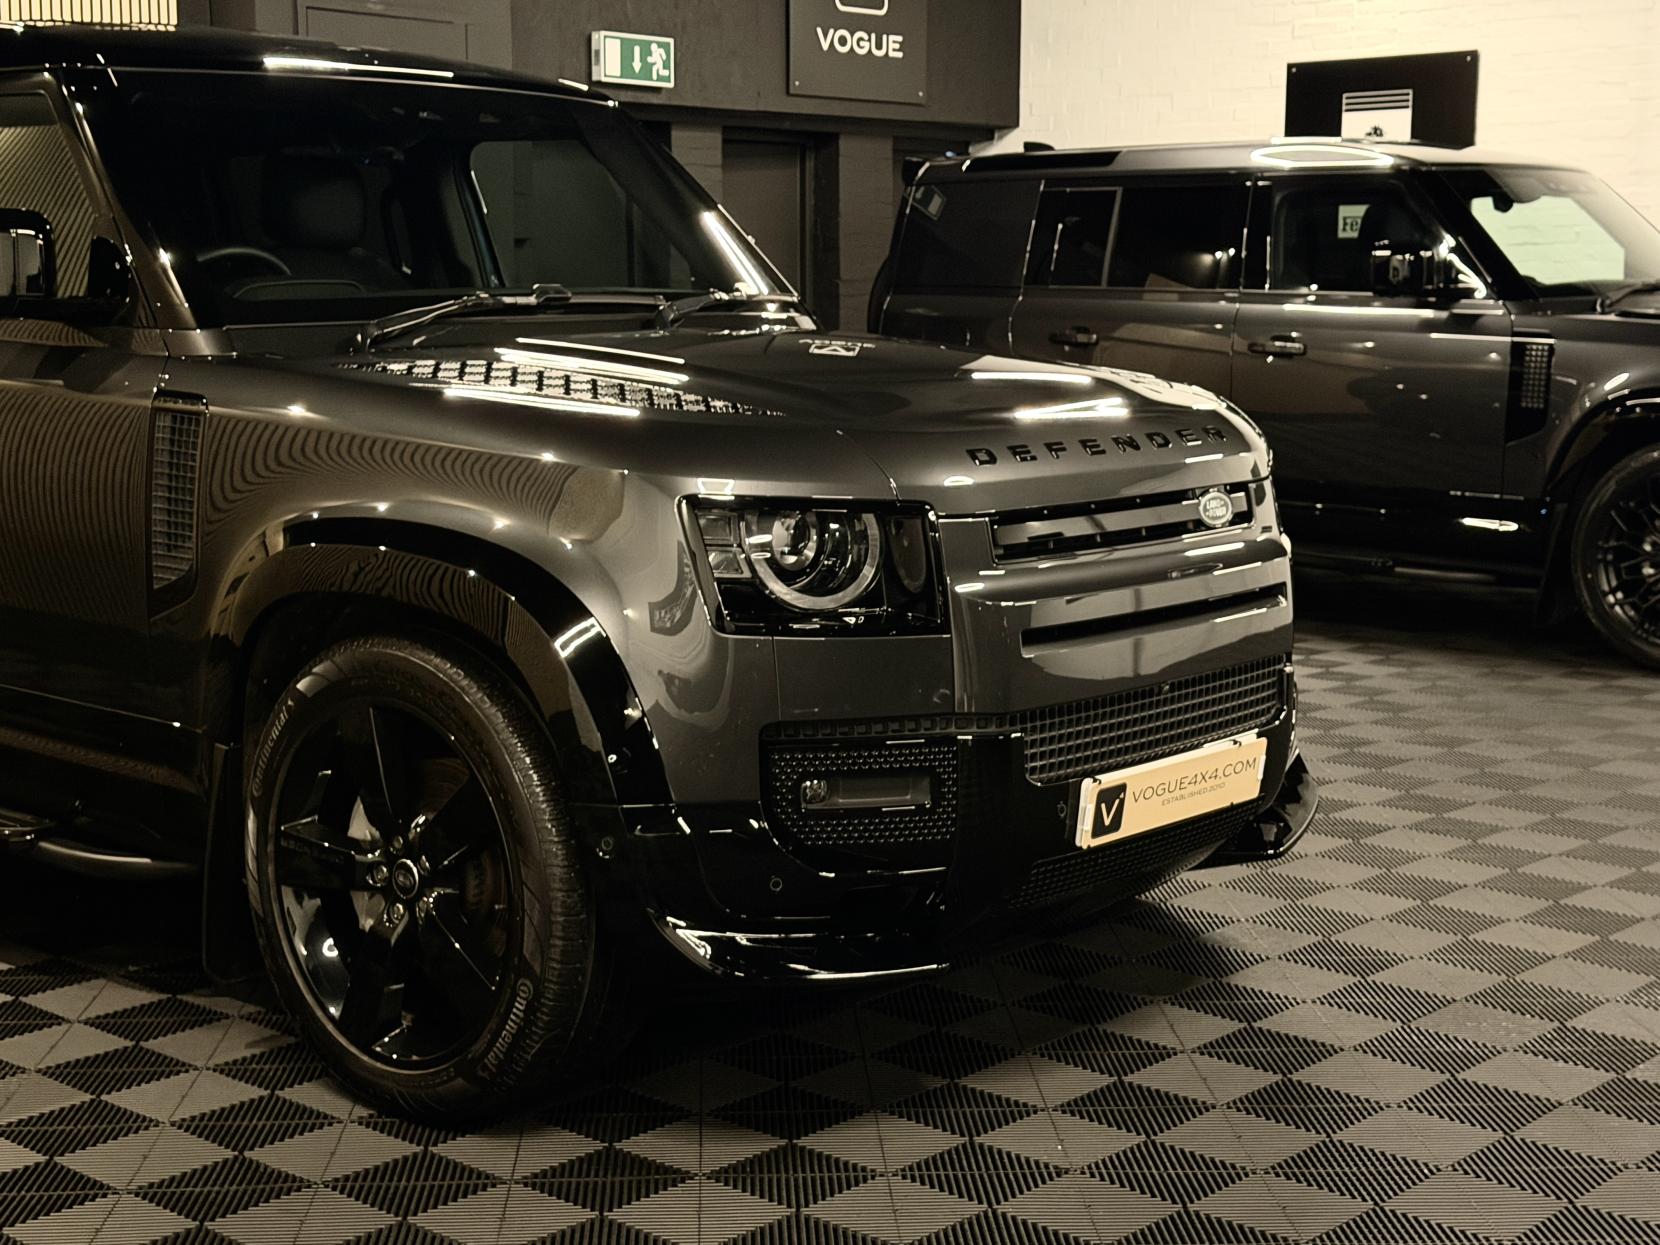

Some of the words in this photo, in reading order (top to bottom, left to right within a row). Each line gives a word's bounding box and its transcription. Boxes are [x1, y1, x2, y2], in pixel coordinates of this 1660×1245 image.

[815, 26, 904, 59] VOGUE
[966, 425, 1227, 466] DEFENDER
[1133, 757, 1257, 803] VOGUE4X4.COM
[1101, 793, 1124, 826] V
[484, 977, 534, 1072] Continental
